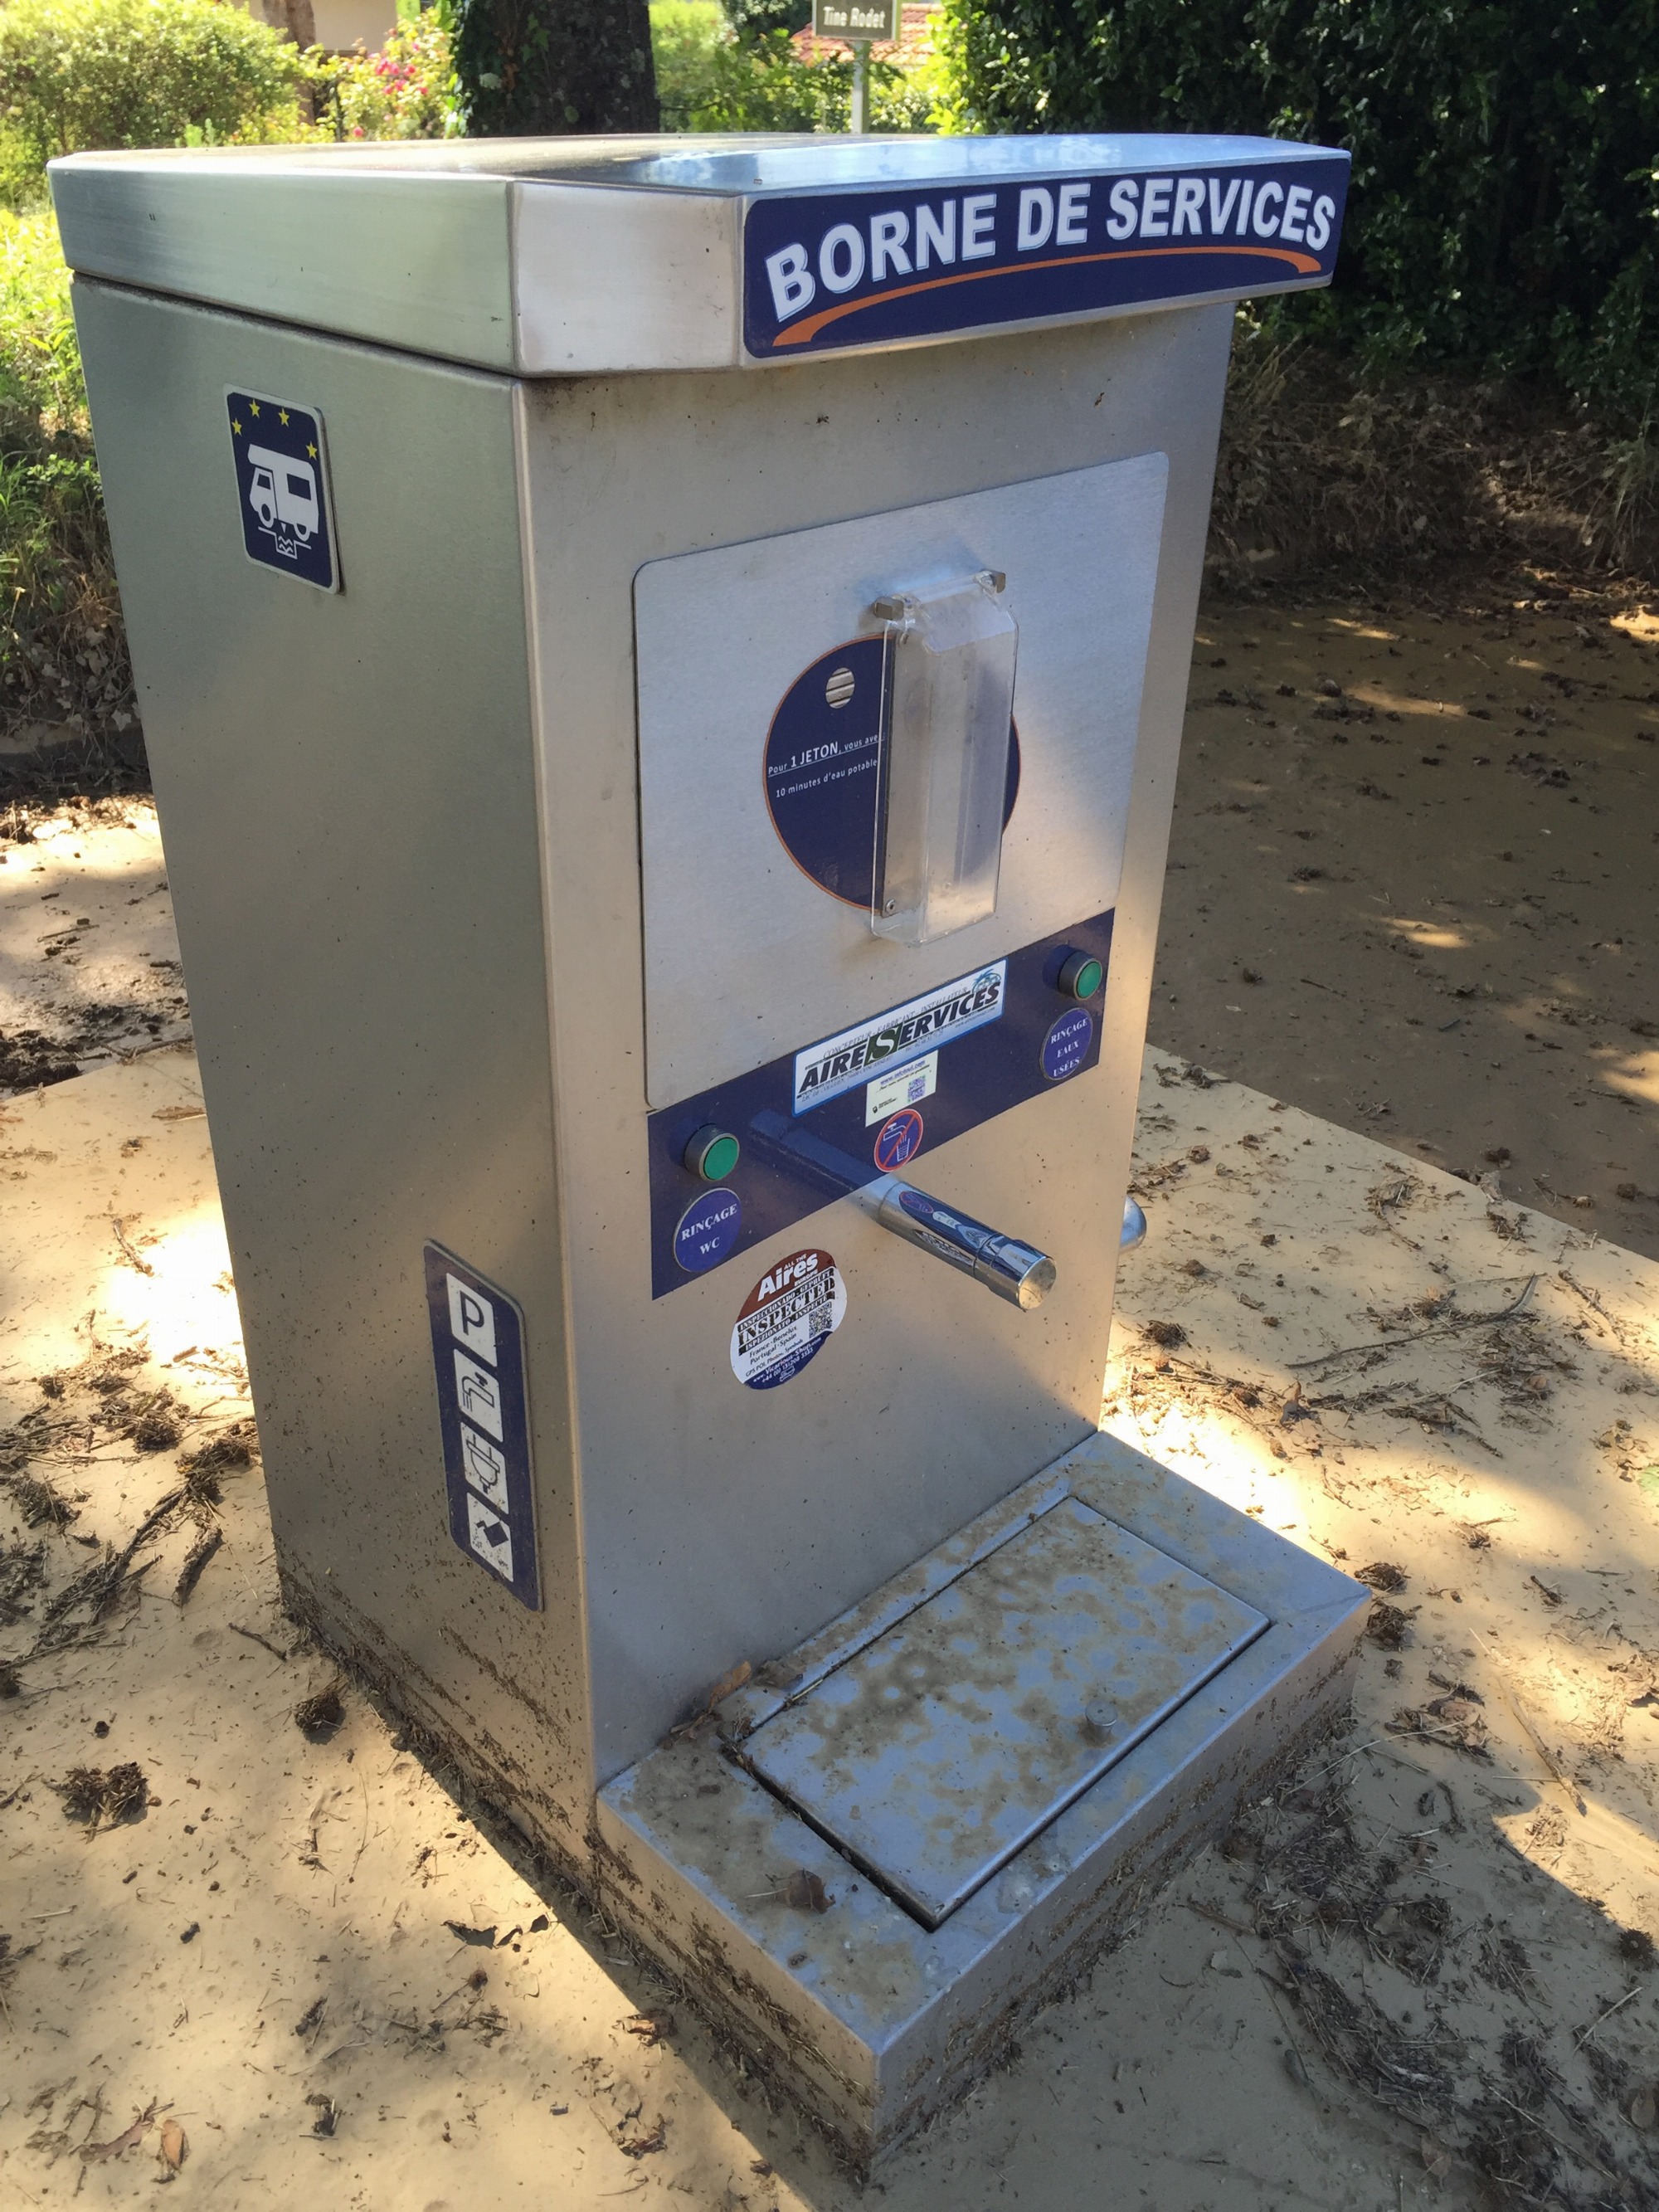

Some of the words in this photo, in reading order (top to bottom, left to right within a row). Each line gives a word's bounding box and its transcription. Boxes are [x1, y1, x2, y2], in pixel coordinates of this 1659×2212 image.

[765, 193, 997, 323] BORNE
[1017, 182, 1092, 251] DE
[1106, 177, 1336, 251] SERVICES
[768, 763, 788, 775] Pour
[791, 755, 797, 768] 1
[844, 738, 863, 751] vous
[864, 733, 881, 744] ave
[776, 787, 786, 798] 10
[787, 777, 821, 795] minutes
[823, 770, 846, 783] d'eau
[847, 758, 878, 777] potable
[1051, 1017, 1088, 1045] RINÇAGE
[1057, 1039, 1079, 1058] EAUX
[1053, 1056, 1080, 1077] USÉES
[681, 1202, 737, 1241] RINÇAGE
[699, 1236, 720, 1255] WC
[784, 1260, 795, 1270] ALL
[795, 1253, 807, 1262] THE
[757, 1252, 818, 1303] Aires
[795, 1269, 819, 1287] EUROPE
[459, 1289, 485, 1336] P
[737, 1277, 835, 1347] INSPECTED
[749, 1342, 771, 1358] France
[772, 1325, 798, 1344] Benelux
[750, 1344, 777, 1366] Portugal
[779, 1333, 797, 1347] Spain
